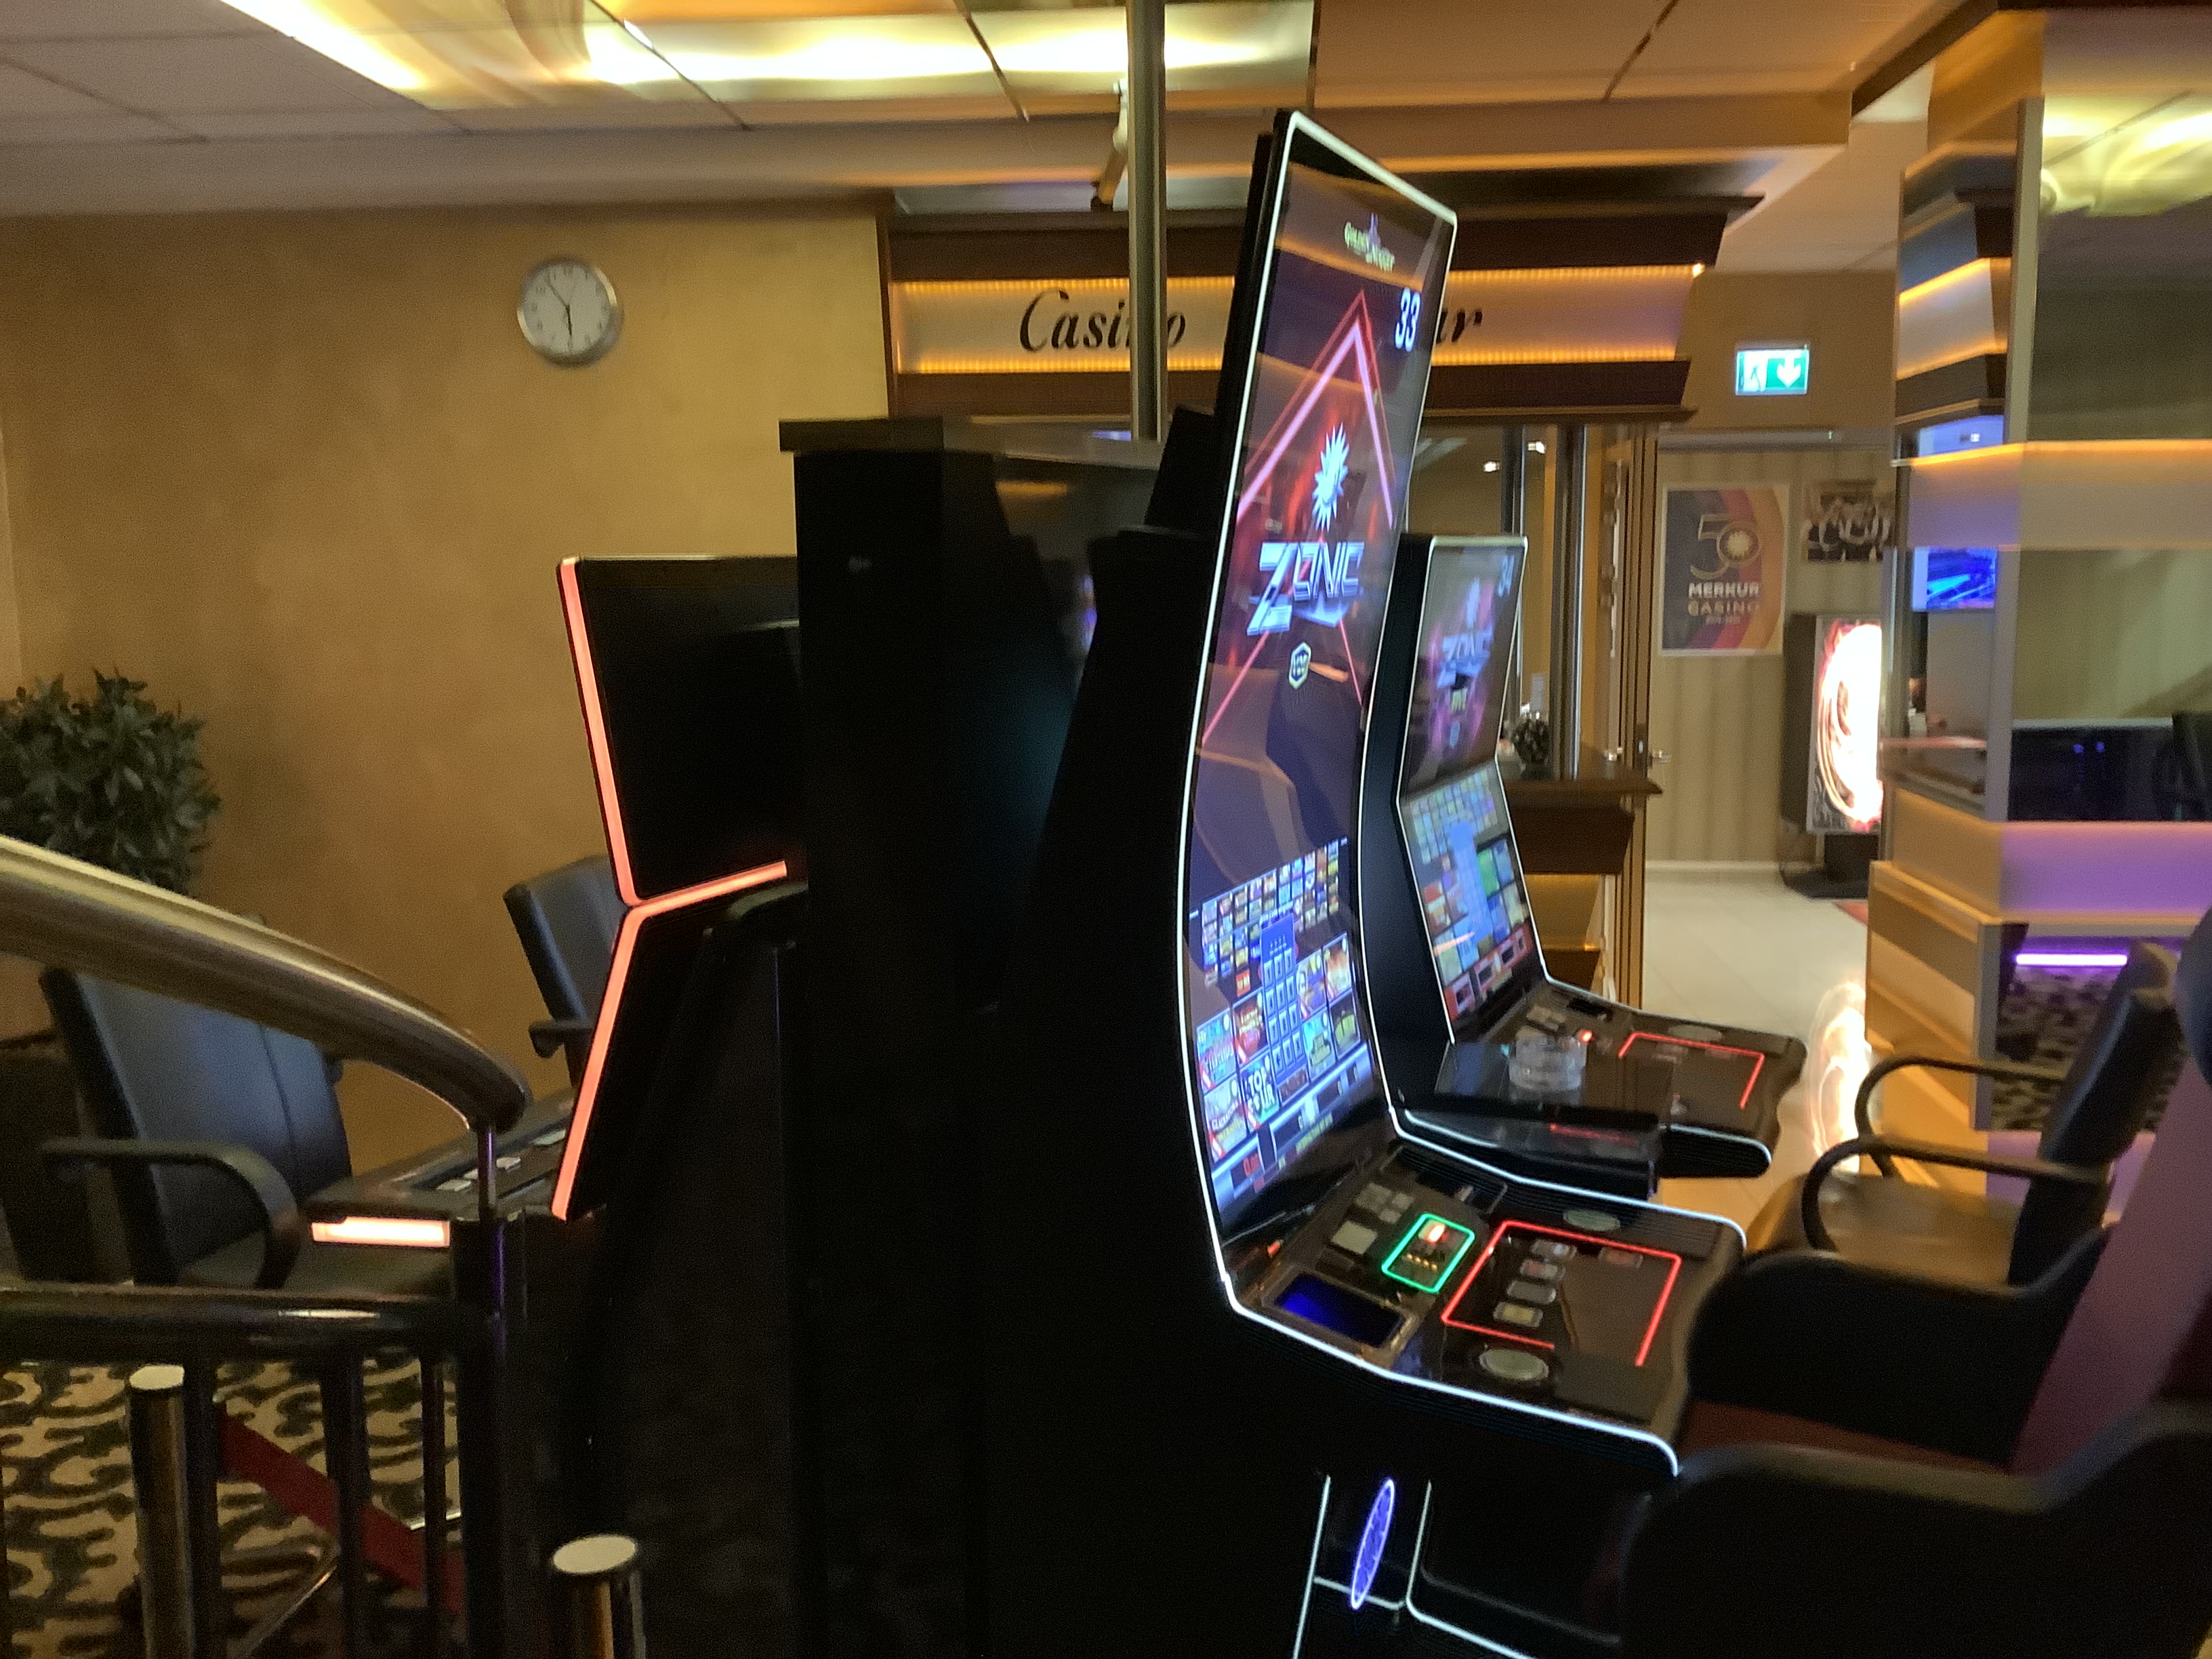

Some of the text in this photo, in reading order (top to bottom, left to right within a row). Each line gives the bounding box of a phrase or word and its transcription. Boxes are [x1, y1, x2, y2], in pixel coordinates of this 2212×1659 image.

[1020, 287, 1185, 352] Casio
[1395, 287, 1420, 352] 33
[1687, 600, 1760, 617] CASINO
[1688, 582, 1759, 598] MERKUR
